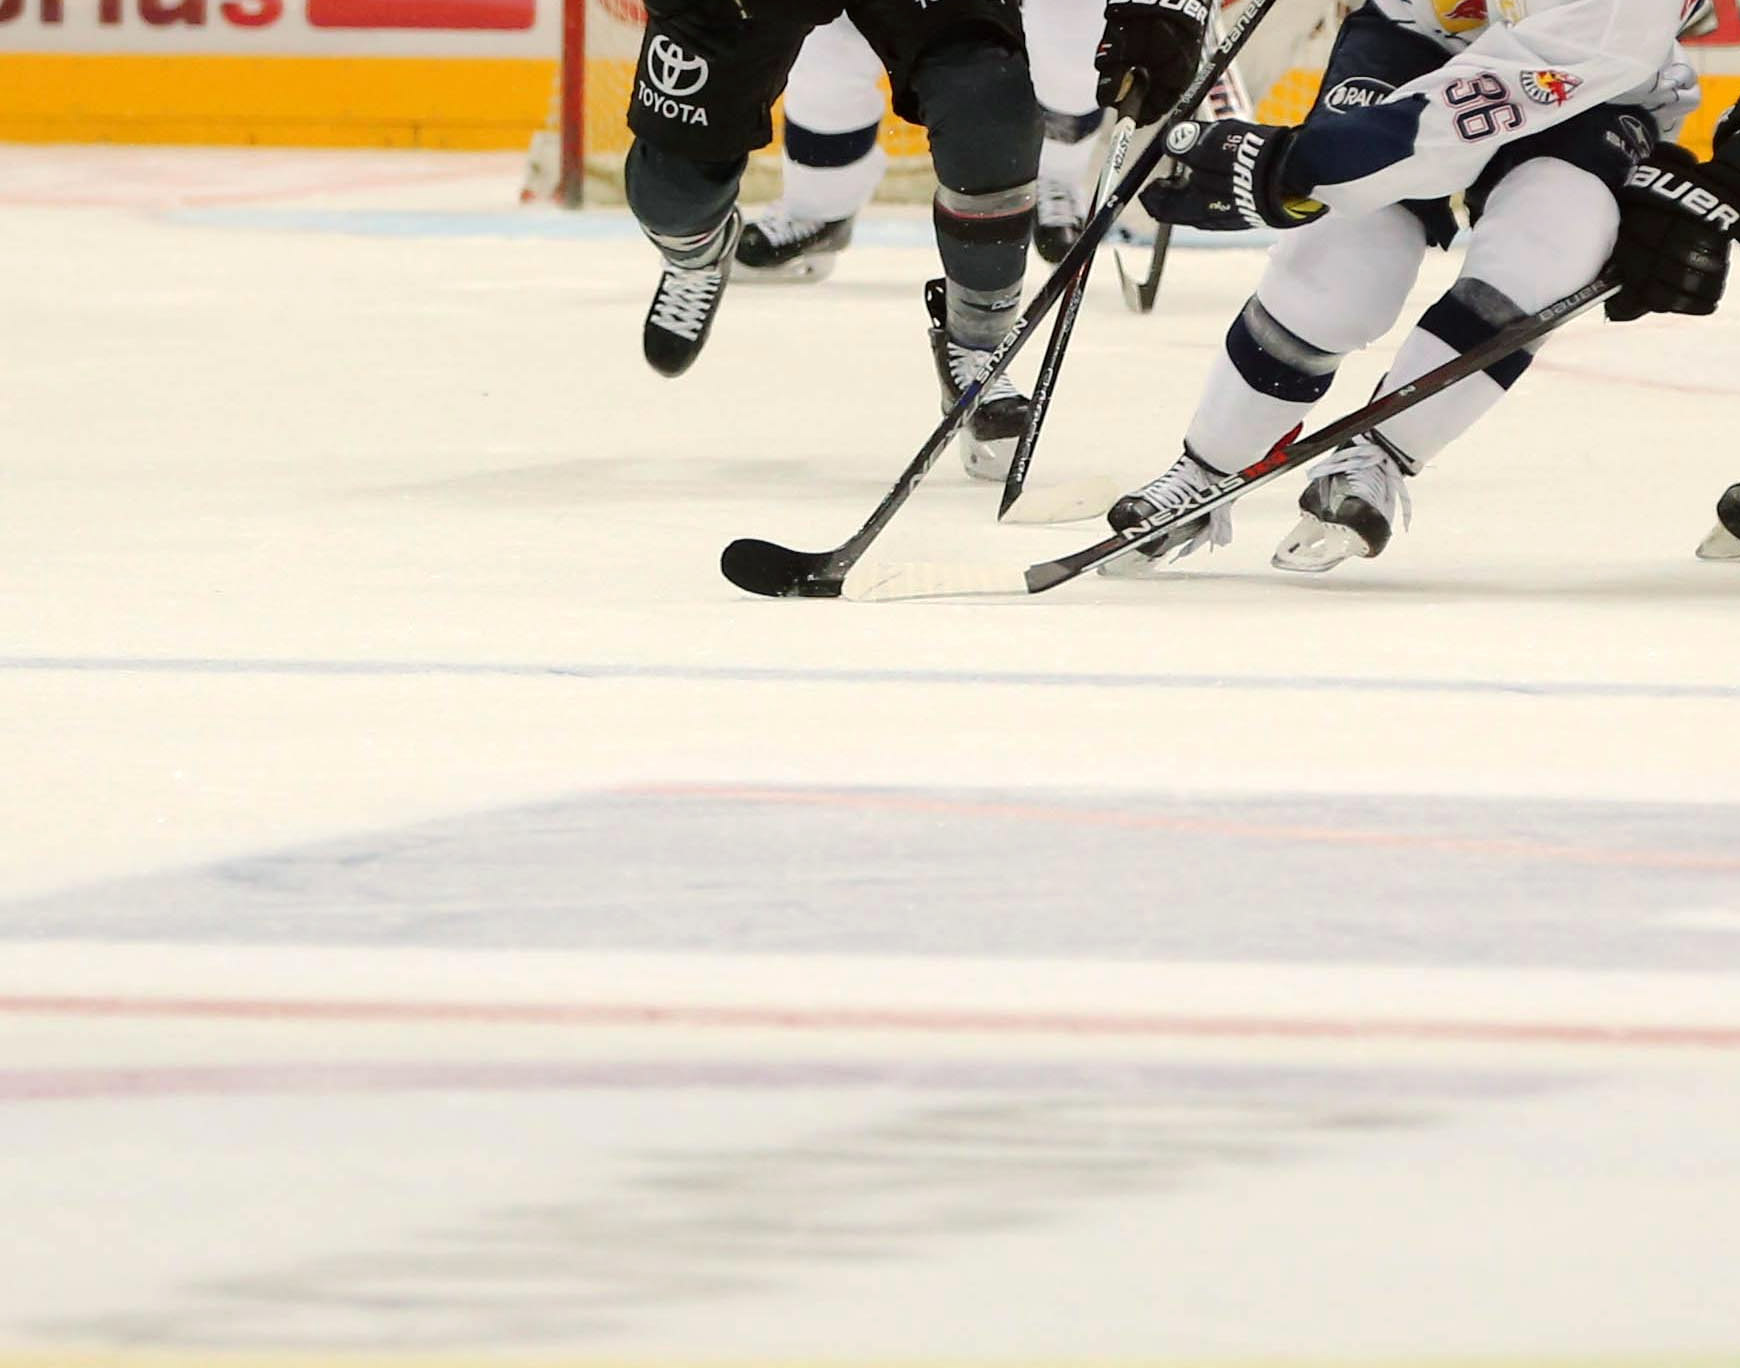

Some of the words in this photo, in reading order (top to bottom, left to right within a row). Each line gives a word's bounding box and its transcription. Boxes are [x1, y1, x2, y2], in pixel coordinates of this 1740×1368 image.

[637, 80, 709, 127] TOYOTA
[1444, 71, 1527, 144] 36
[1222, 134, 1243, 153] 36
[975, 316, 1029, 385] NEXUS
[1121, 474, 1247, 541] NEXUS
